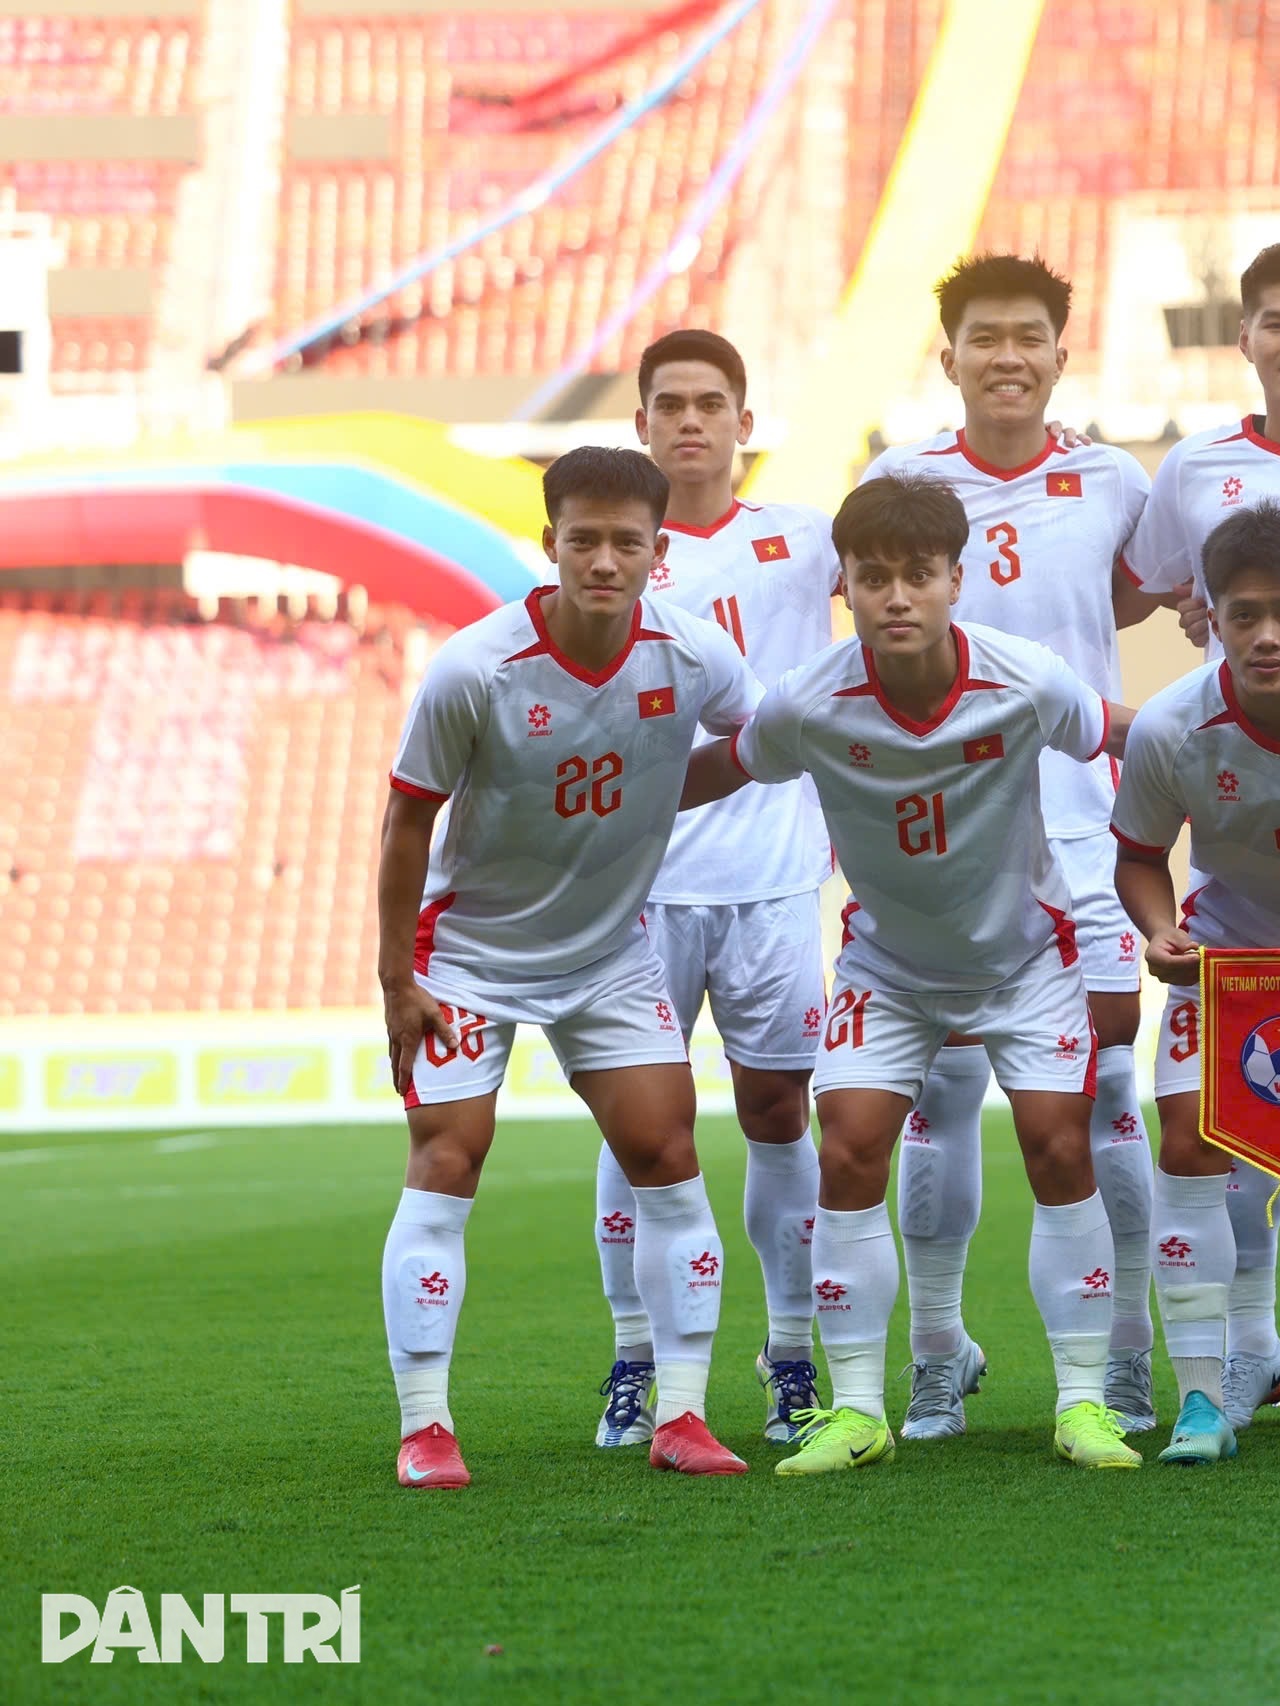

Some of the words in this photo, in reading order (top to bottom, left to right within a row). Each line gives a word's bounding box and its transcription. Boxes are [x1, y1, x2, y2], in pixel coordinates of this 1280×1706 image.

[987, 523, 1020, 586] 3
[554, 751, 623, 819] 22
[895, 791, 948, 857] 21
[1221, 976, 1257, 992] VIETNAM
[824, 988, 873, 1053] 21
[1169, 1000, 1199, 1063] 9
